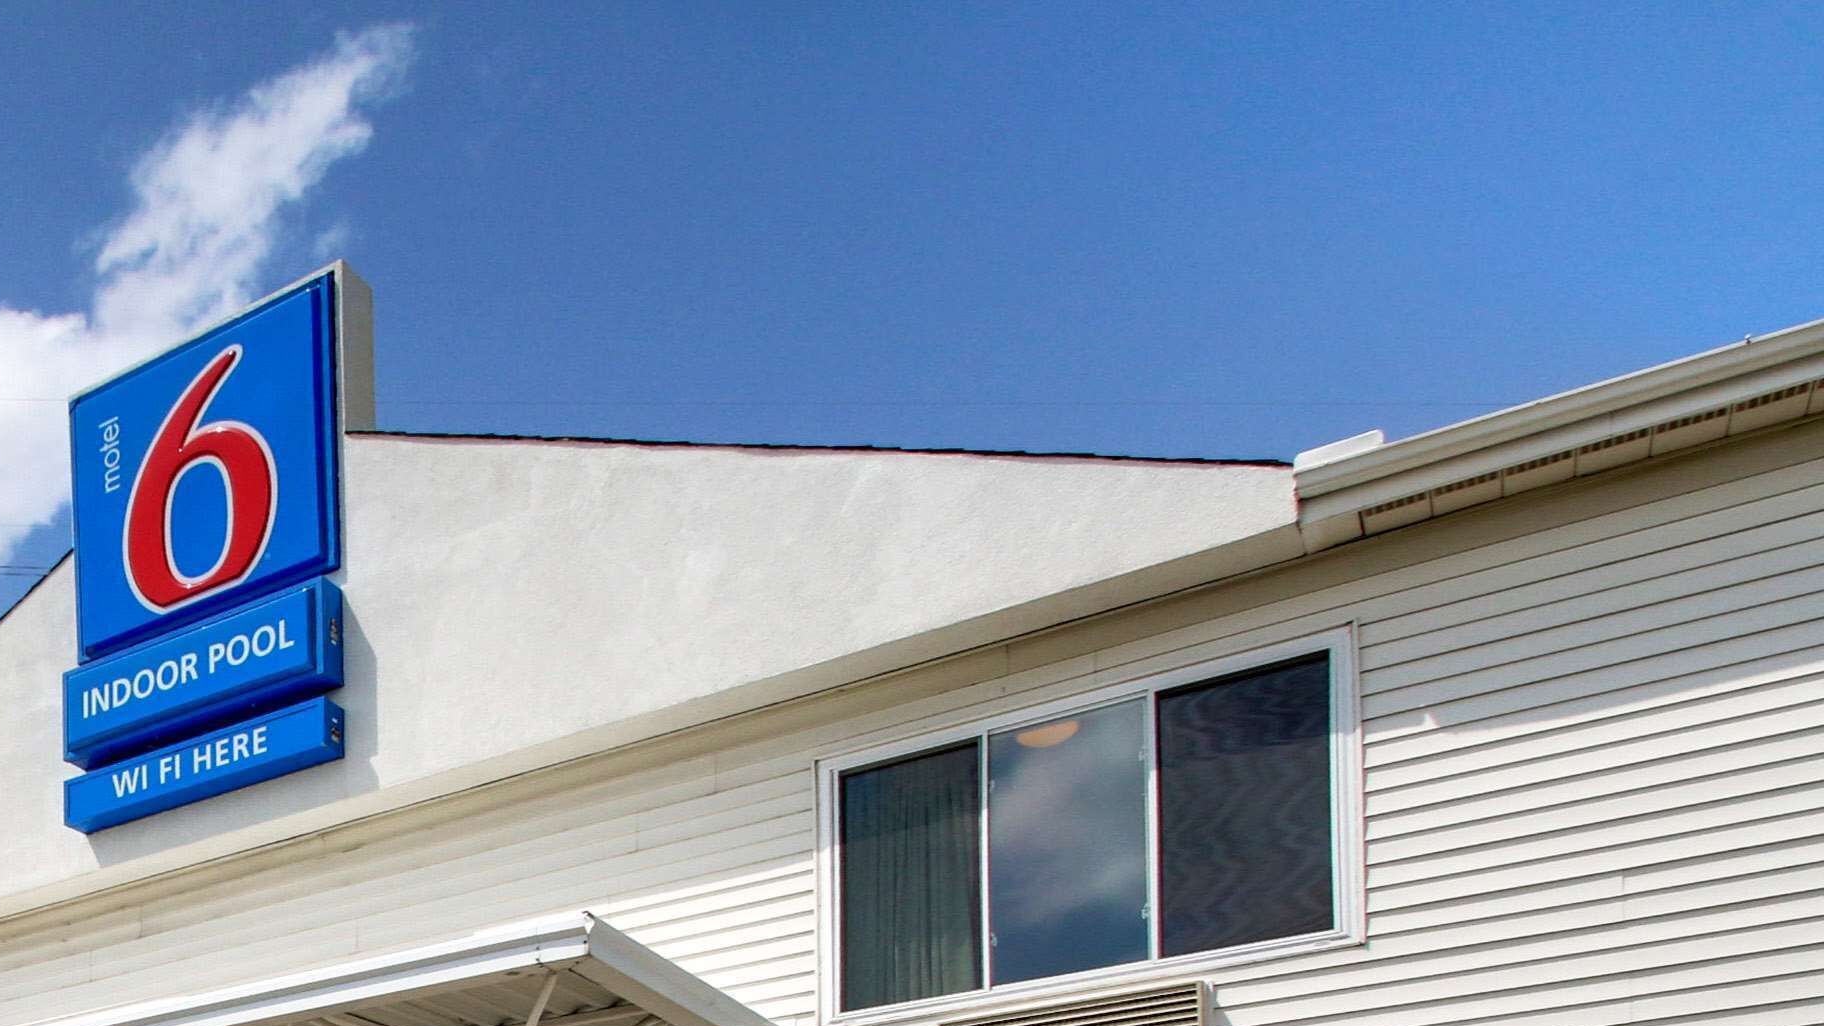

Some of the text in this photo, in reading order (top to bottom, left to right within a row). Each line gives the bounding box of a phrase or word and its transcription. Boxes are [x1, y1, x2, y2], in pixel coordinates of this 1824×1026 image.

[98, 342, 278, 615] motel 6
[82, 619, 295, 719] INDOOR POOL
[112, 726, 268, 798] WI FI HERE
